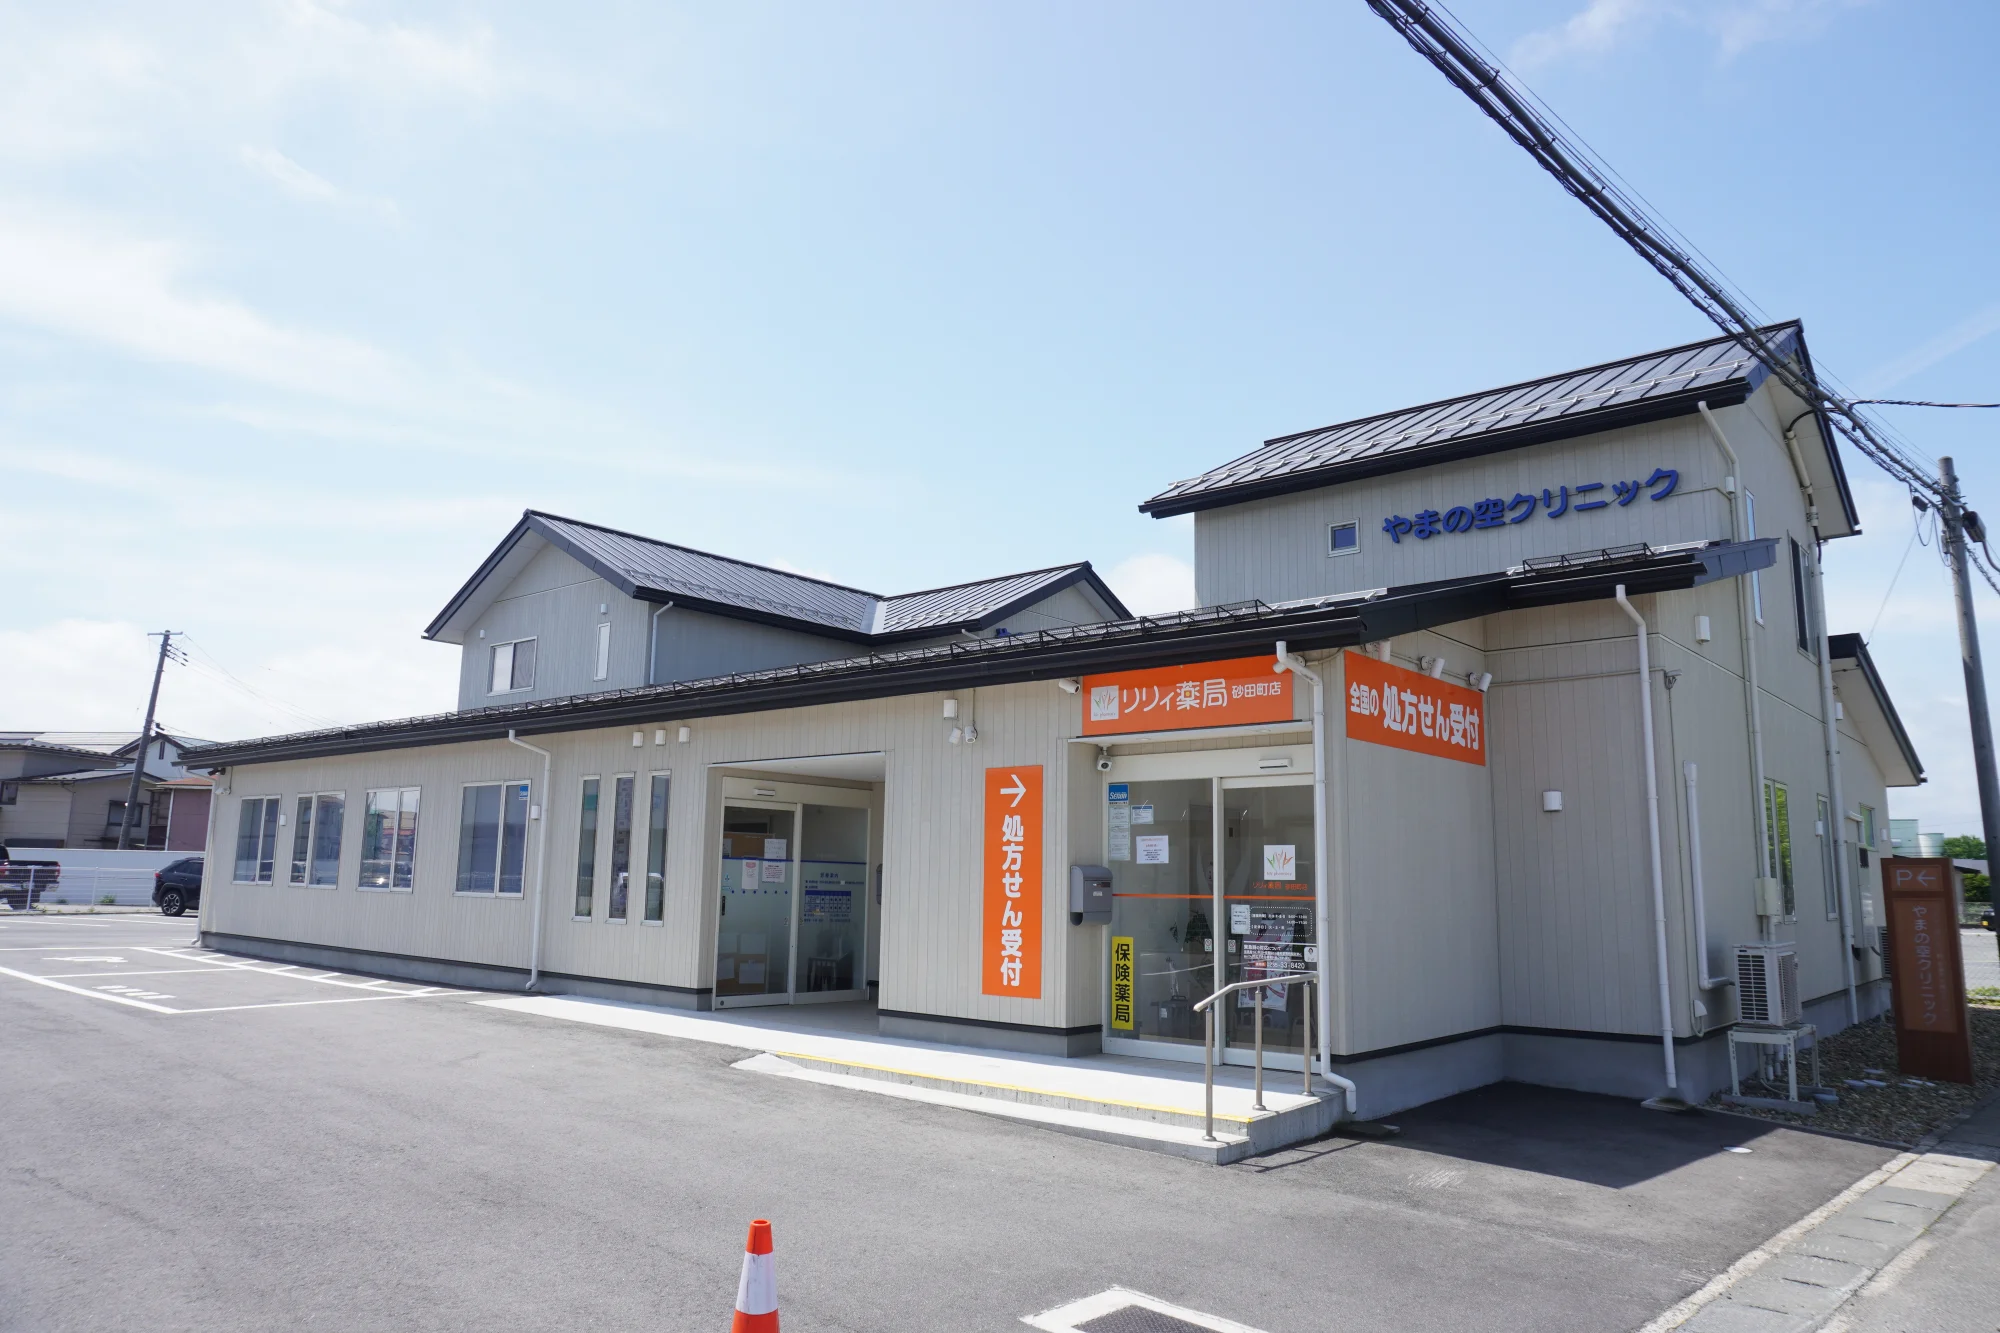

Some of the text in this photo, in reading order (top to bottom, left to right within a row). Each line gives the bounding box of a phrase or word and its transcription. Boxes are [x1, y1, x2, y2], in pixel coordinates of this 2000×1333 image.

[1382, 468, 1679, 543] やまの空クリニック
[1123, 678, 1282, 713] リリィ薬局 砂田町店
[1350, 681, 1480, 751] 全国の 処方せん受付
[1000, 814, 1024, 987] 処方せん受付
[1896, 869, 1913, 887] P
[1115, 943, 1130, 1023] 保険薬局
[1911, 905, 1938, 1026] やまの空クリニック
